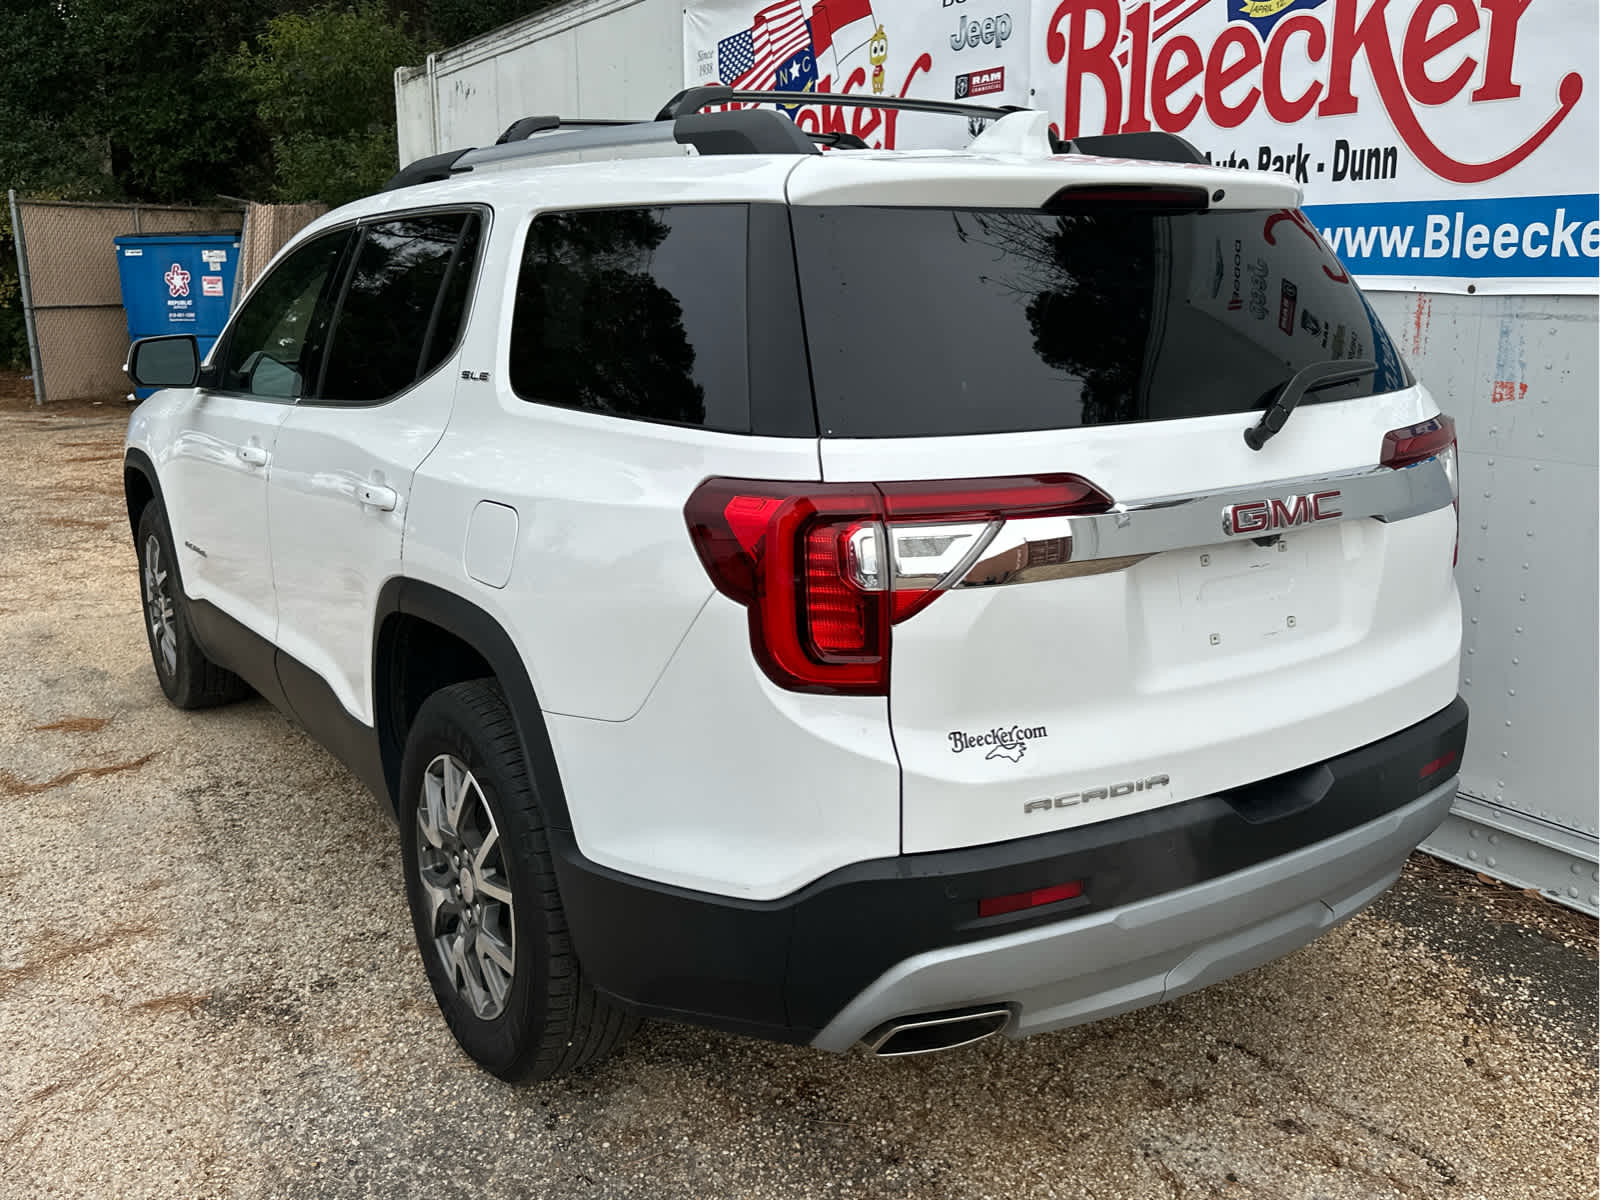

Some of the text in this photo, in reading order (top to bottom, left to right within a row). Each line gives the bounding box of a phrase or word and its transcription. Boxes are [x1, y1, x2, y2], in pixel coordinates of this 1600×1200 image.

[950, 13, 1013, 52] Jeep
[779, 56, 812, 87] N C
[972, 71, 1002, 85] RAM
[1332, 139, 1398, 182] Dunn
[461, 370, 490, 382] SLE
[1223, 490, 1343, 535] GMC
[1023, 773, 1170, 814] ACADIA
